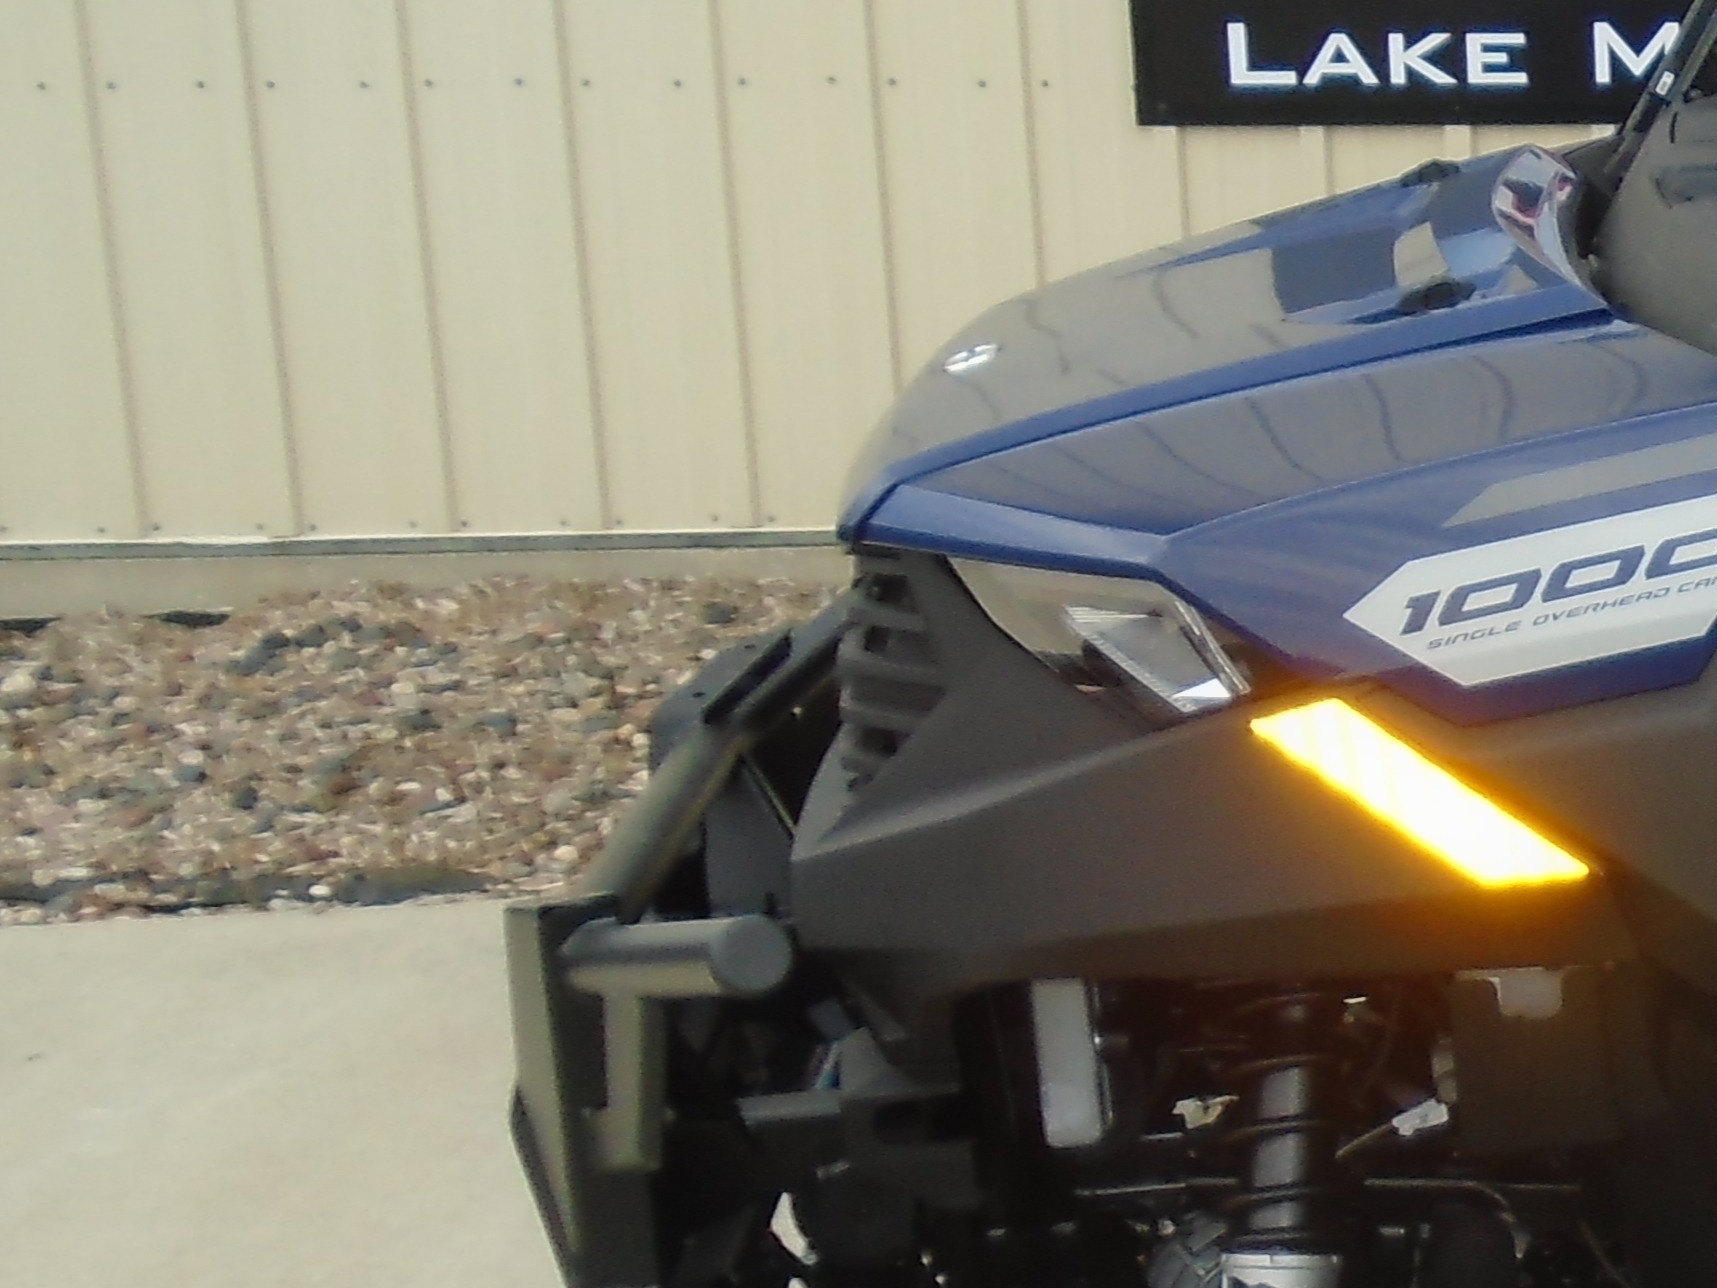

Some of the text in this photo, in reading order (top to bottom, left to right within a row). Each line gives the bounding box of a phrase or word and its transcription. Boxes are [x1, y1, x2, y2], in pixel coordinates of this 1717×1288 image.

[1226, 21, 1530, 86] LAKE
[1427, 620, 1523, 650] SINGLE
[1531, 587, 1670, 627] OVERHEAD
